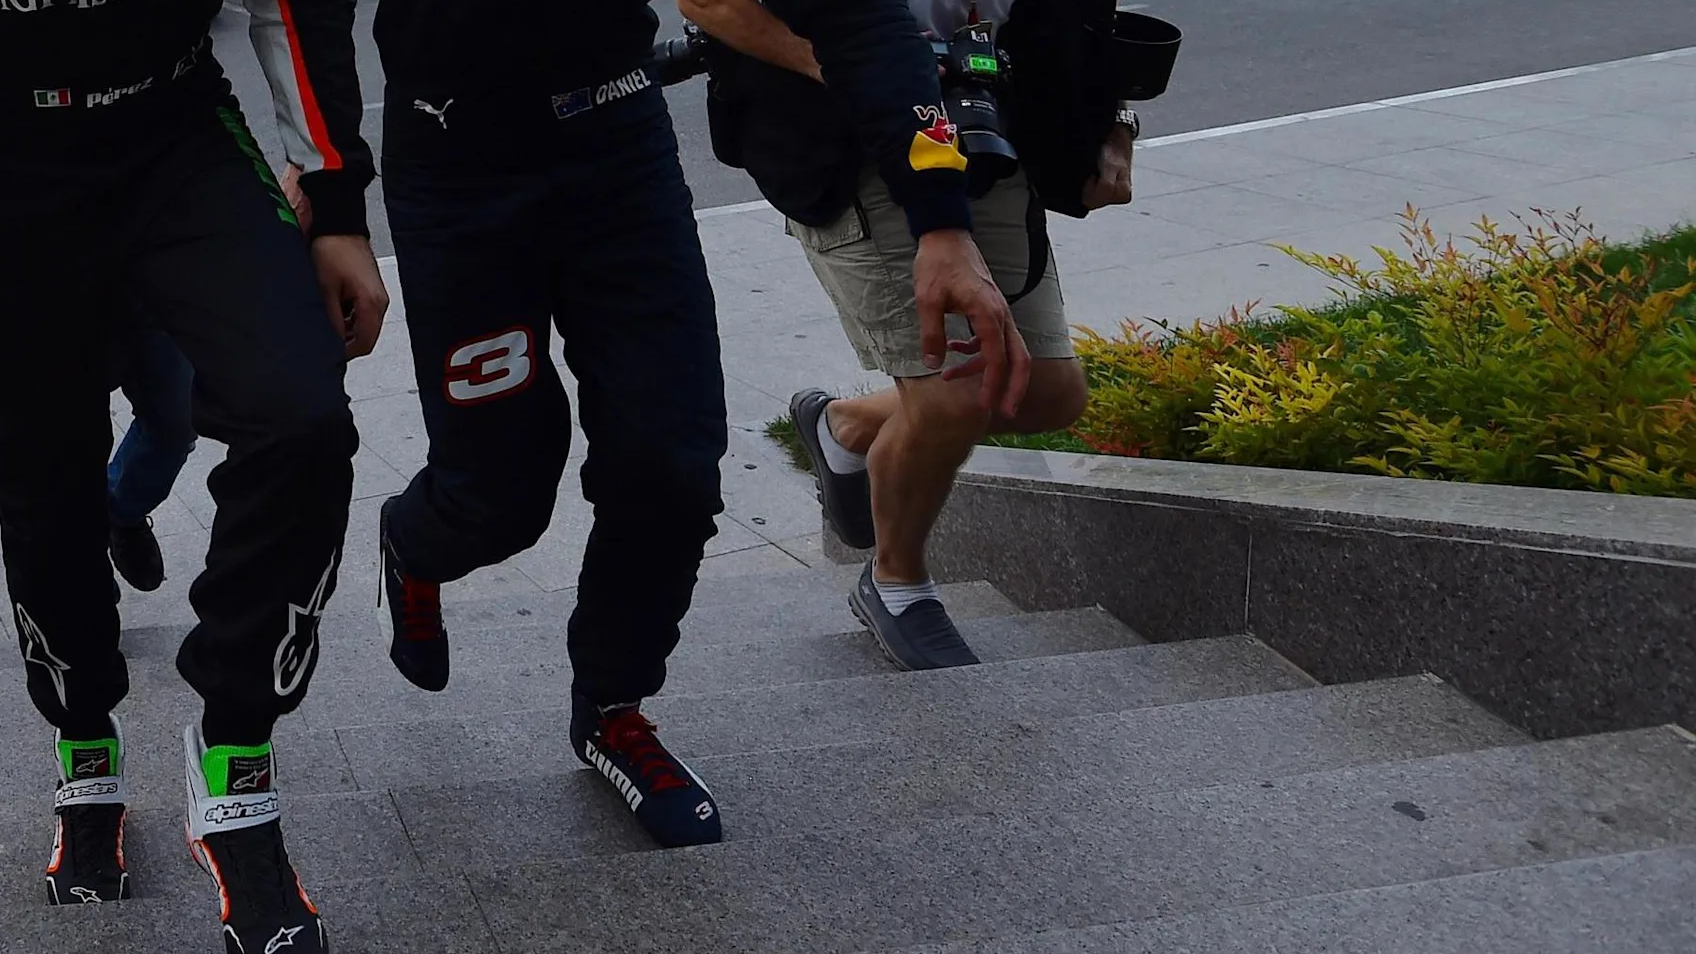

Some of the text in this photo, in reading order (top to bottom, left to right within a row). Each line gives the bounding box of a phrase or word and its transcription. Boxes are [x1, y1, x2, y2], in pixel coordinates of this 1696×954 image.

[595, 68, 651, 106] DANIEL
[445, 326, 533, 403] 3
[694, 800, 714, 821] 3
